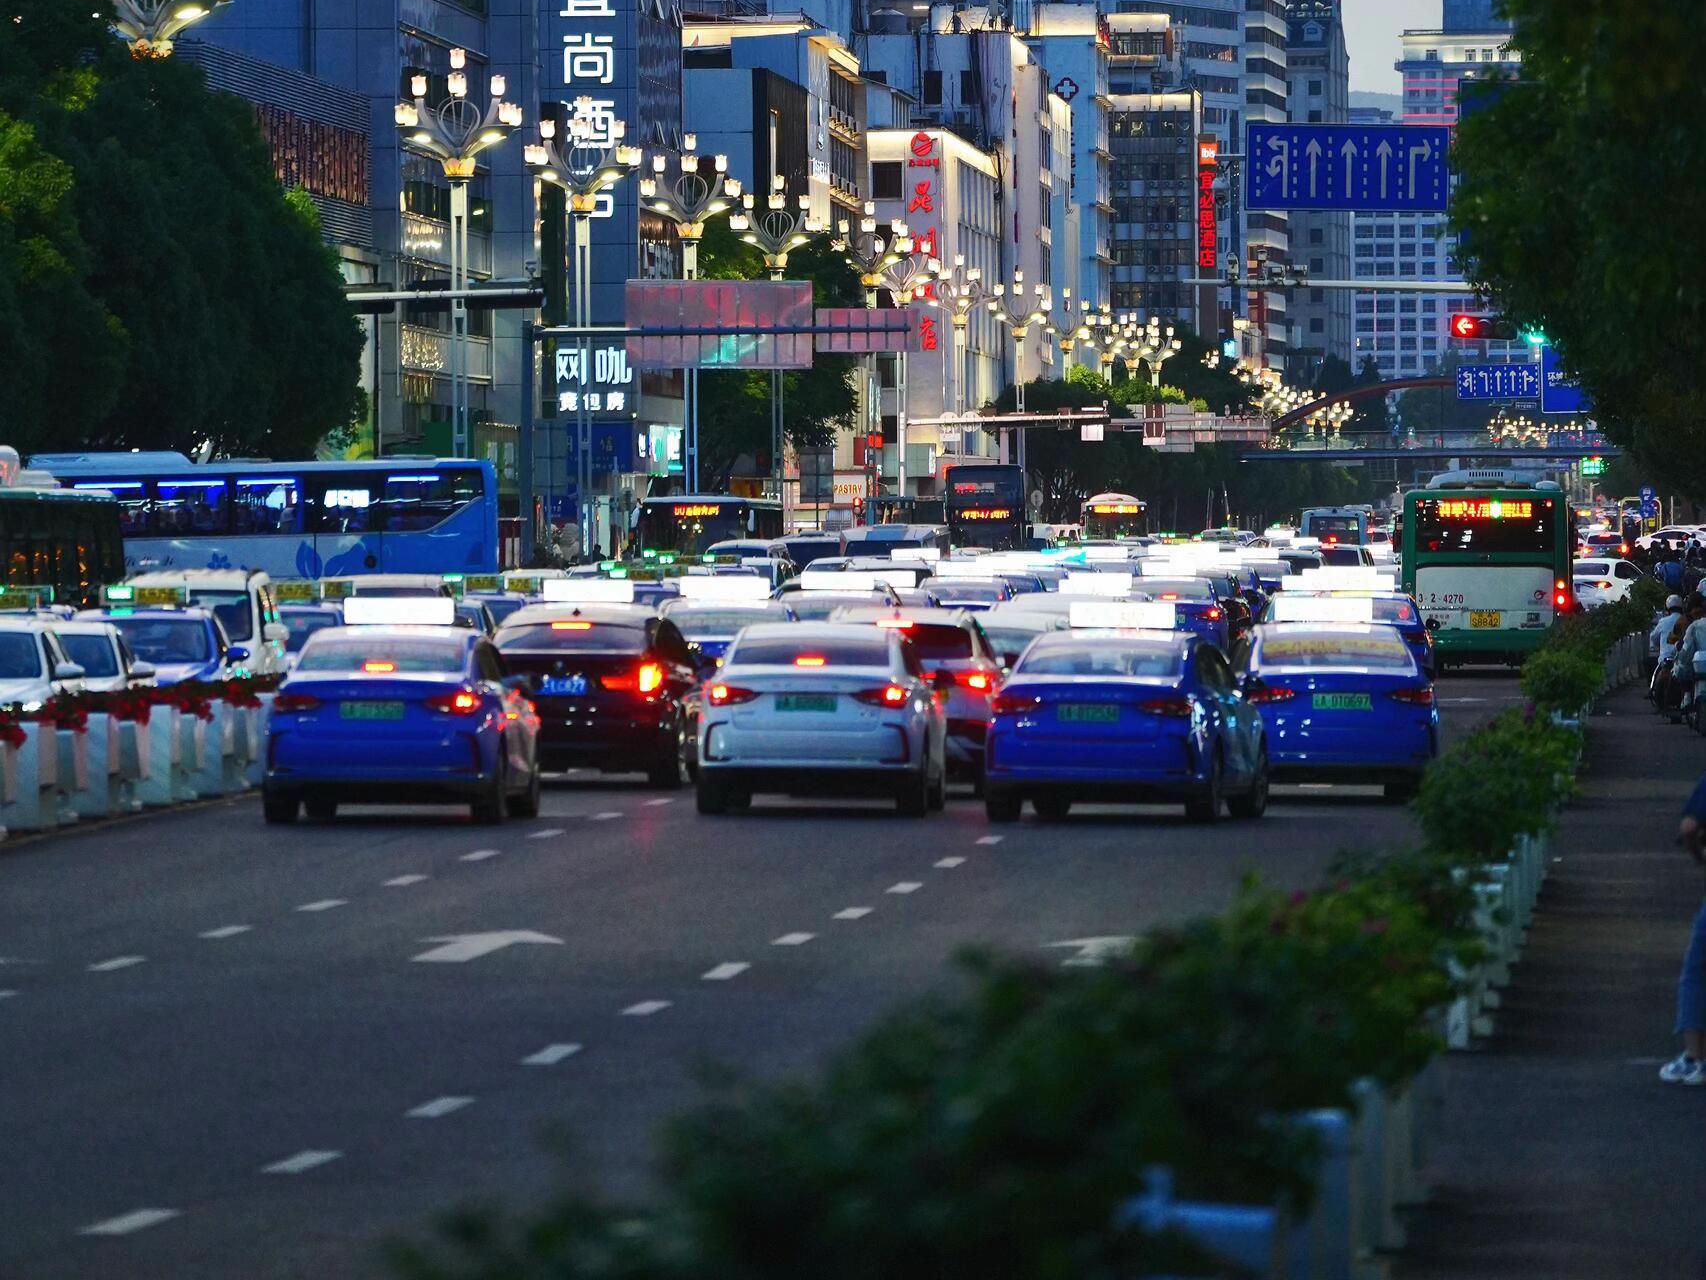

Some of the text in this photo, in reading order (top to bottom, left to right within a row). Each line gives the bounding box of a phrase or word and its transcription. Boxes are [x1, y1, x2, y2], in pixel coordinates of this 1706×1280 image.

[1200, 171, 1217, 267] 宜必思酒店
[555, 346, 633, 386] 网咖
[833, 484, 863, 494] PASTRY
